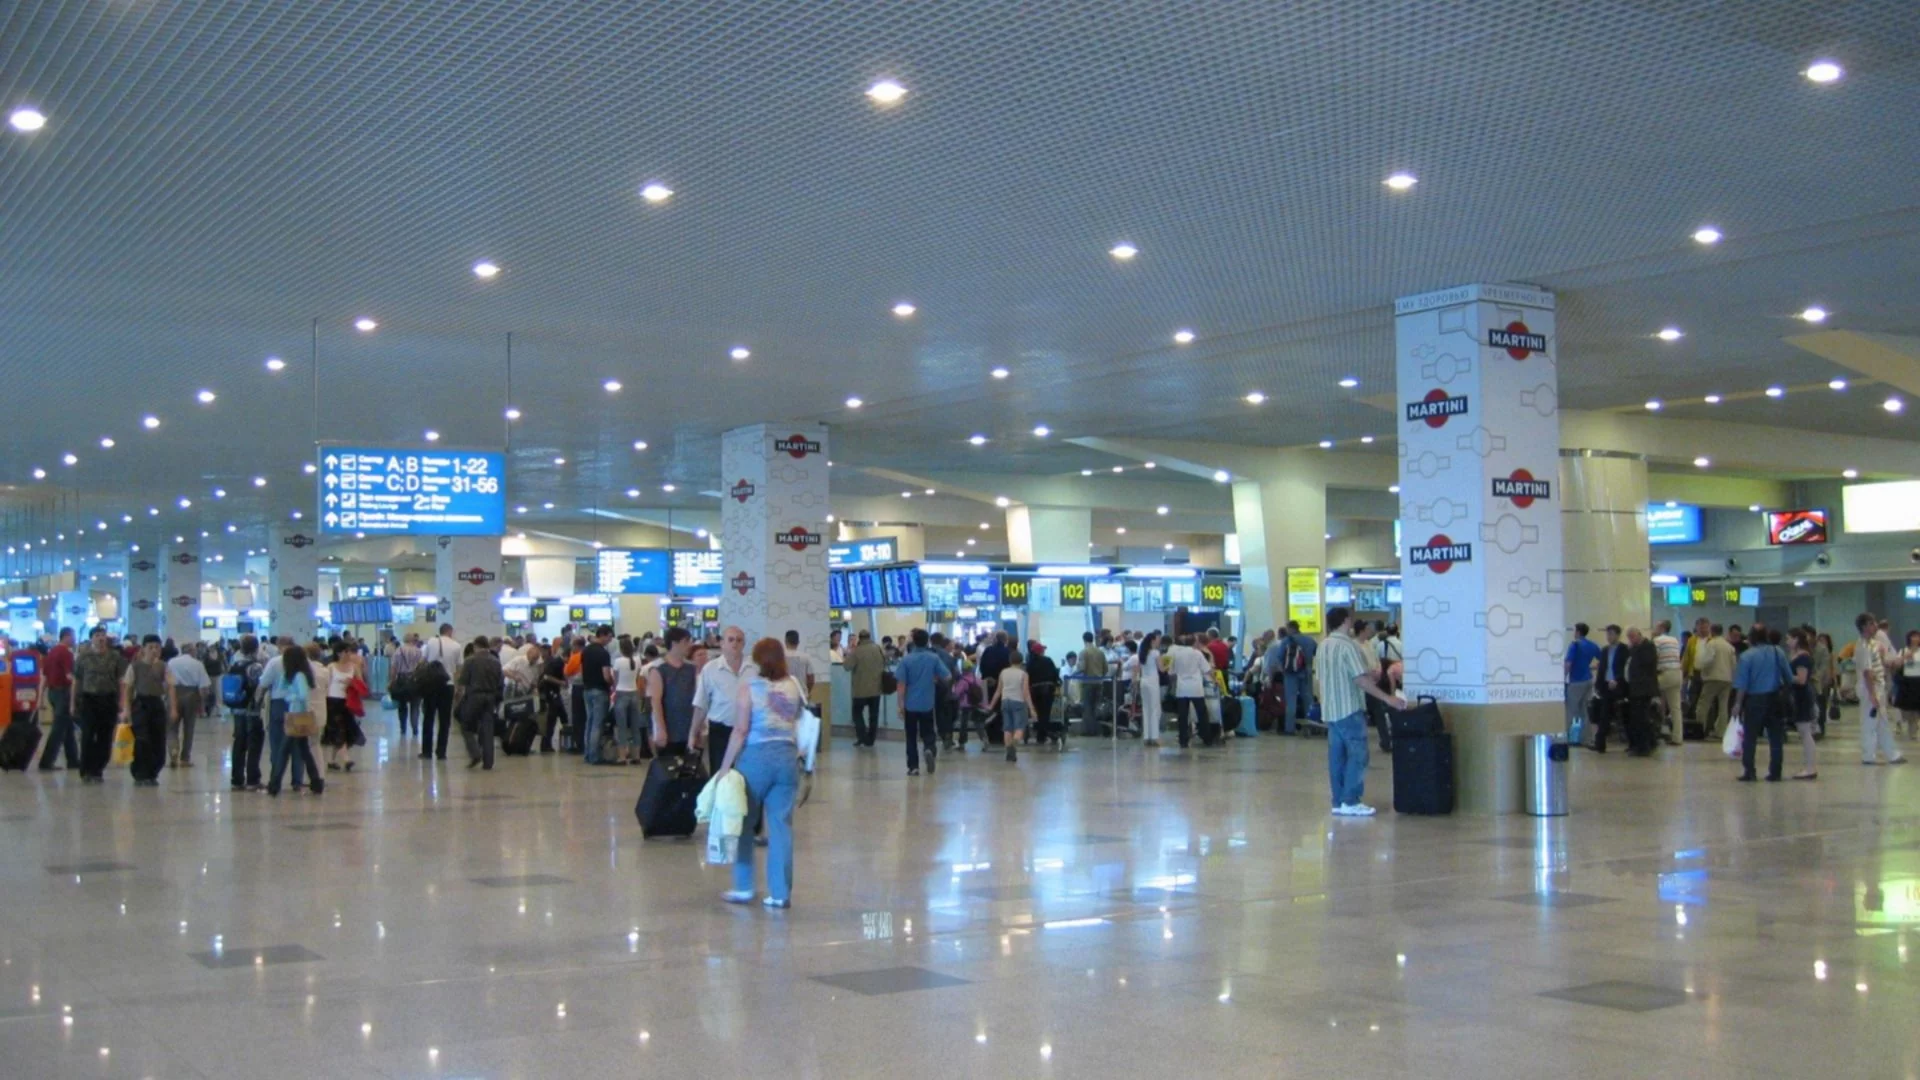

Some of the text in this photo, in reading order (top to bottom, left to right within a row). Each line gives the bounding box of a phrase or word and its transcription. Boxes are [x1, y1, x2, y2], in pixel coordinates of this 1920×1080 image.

[1491, 332, 1544, 349] MARTINI
[1409, 399, 1465, 417] MARTINI
[778, 442, 818, 450] MARTINI
[453, 457, 488, 475] 1-22
[452, 476, 498, 493] 31-56
[1495, 482, 1548, 496] MARTINI
[778, 535, 818, 544] MARTINI
[1412, 547, 1469, 561] MARTINI
[1004, 583, 1026, 597] 101
[1062, 584, 1084, 599] 102
[1203, 585, 1224, 600] 103
